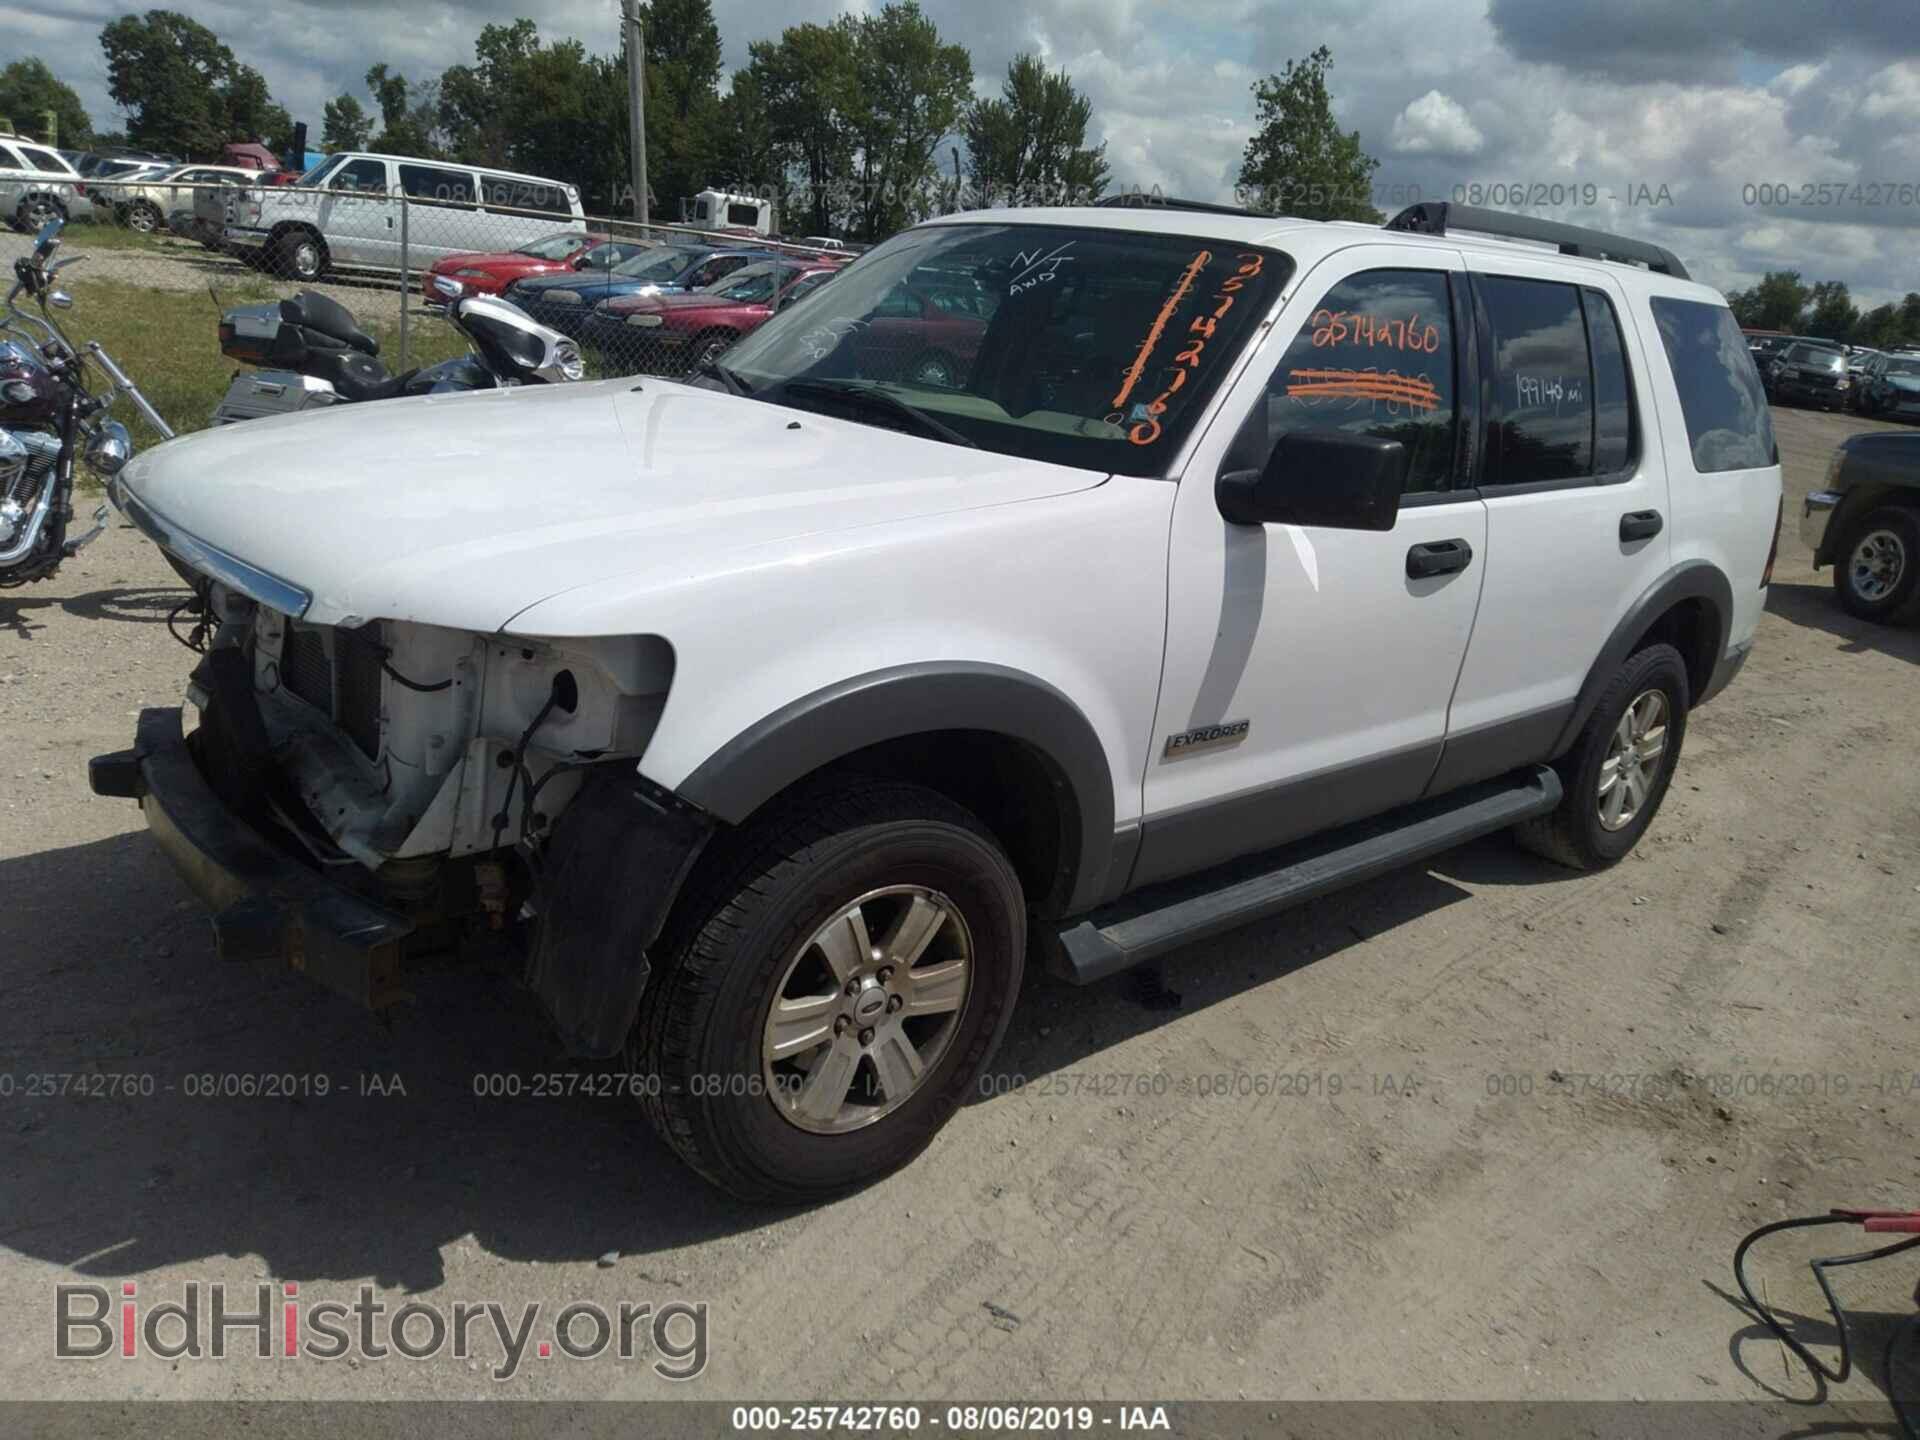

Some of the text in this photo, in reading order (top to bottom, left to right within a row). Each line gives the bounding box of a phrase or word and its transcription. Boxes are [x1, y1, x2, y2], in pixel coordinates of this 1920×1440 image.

[1009, 272, 1056, 296] AWD
[1311, 309, 1440, 353] 25742760
[1172, 721, 1249, 749] EXPLORER
